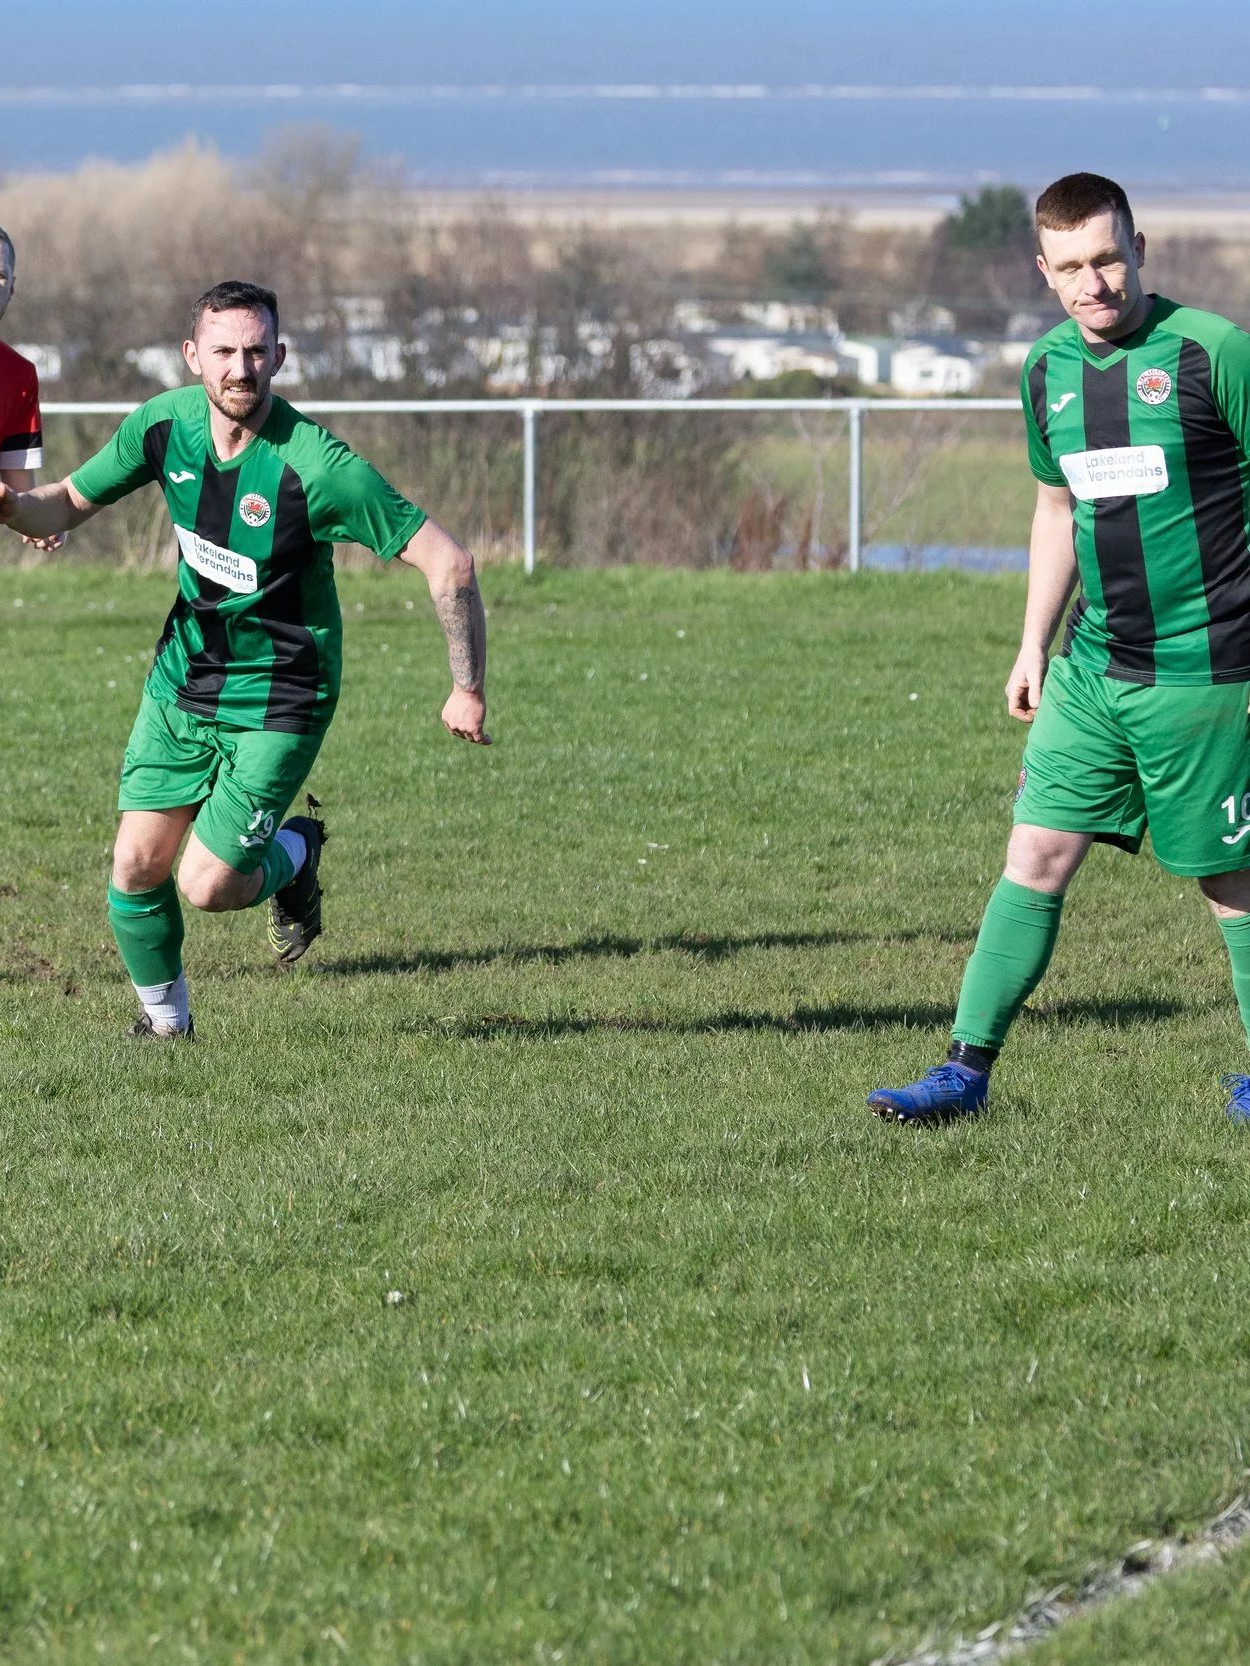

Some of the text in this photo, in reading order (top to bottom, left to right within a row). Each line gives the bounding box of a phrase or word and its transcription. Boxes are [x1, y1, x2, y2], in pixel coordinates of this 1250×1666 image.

[1085, 450, 1145, 468] Lakeland
[1088, 464, 1163, 483] Verandahs
[193, 536, 240, 569] Lakeland
[247, 809, 274, 839] 19
